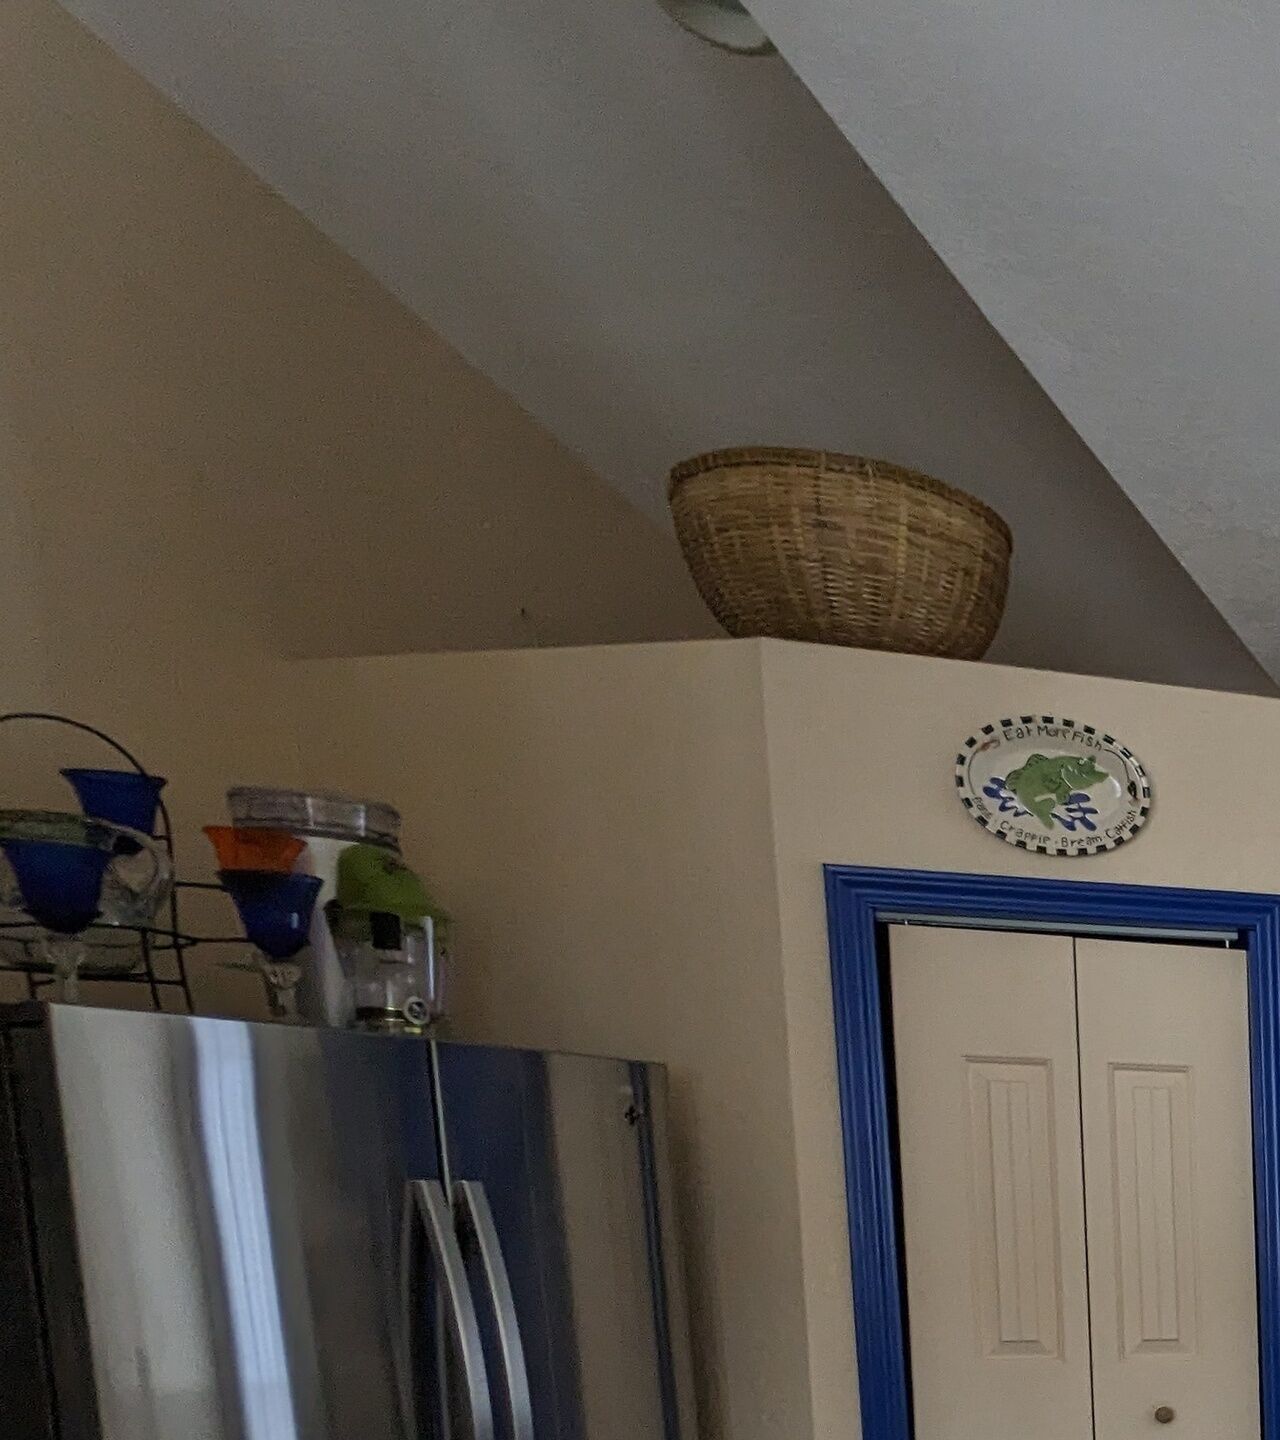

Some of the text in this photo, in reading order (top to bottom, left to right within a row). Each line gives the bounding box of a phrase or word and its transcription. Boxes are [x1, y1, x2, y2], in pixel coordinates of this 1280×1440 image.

[1003, 725, 1032, 742] Eat
[1036, 725, 1071, 739] More
[1061, 835, 1103, 848] Bream
